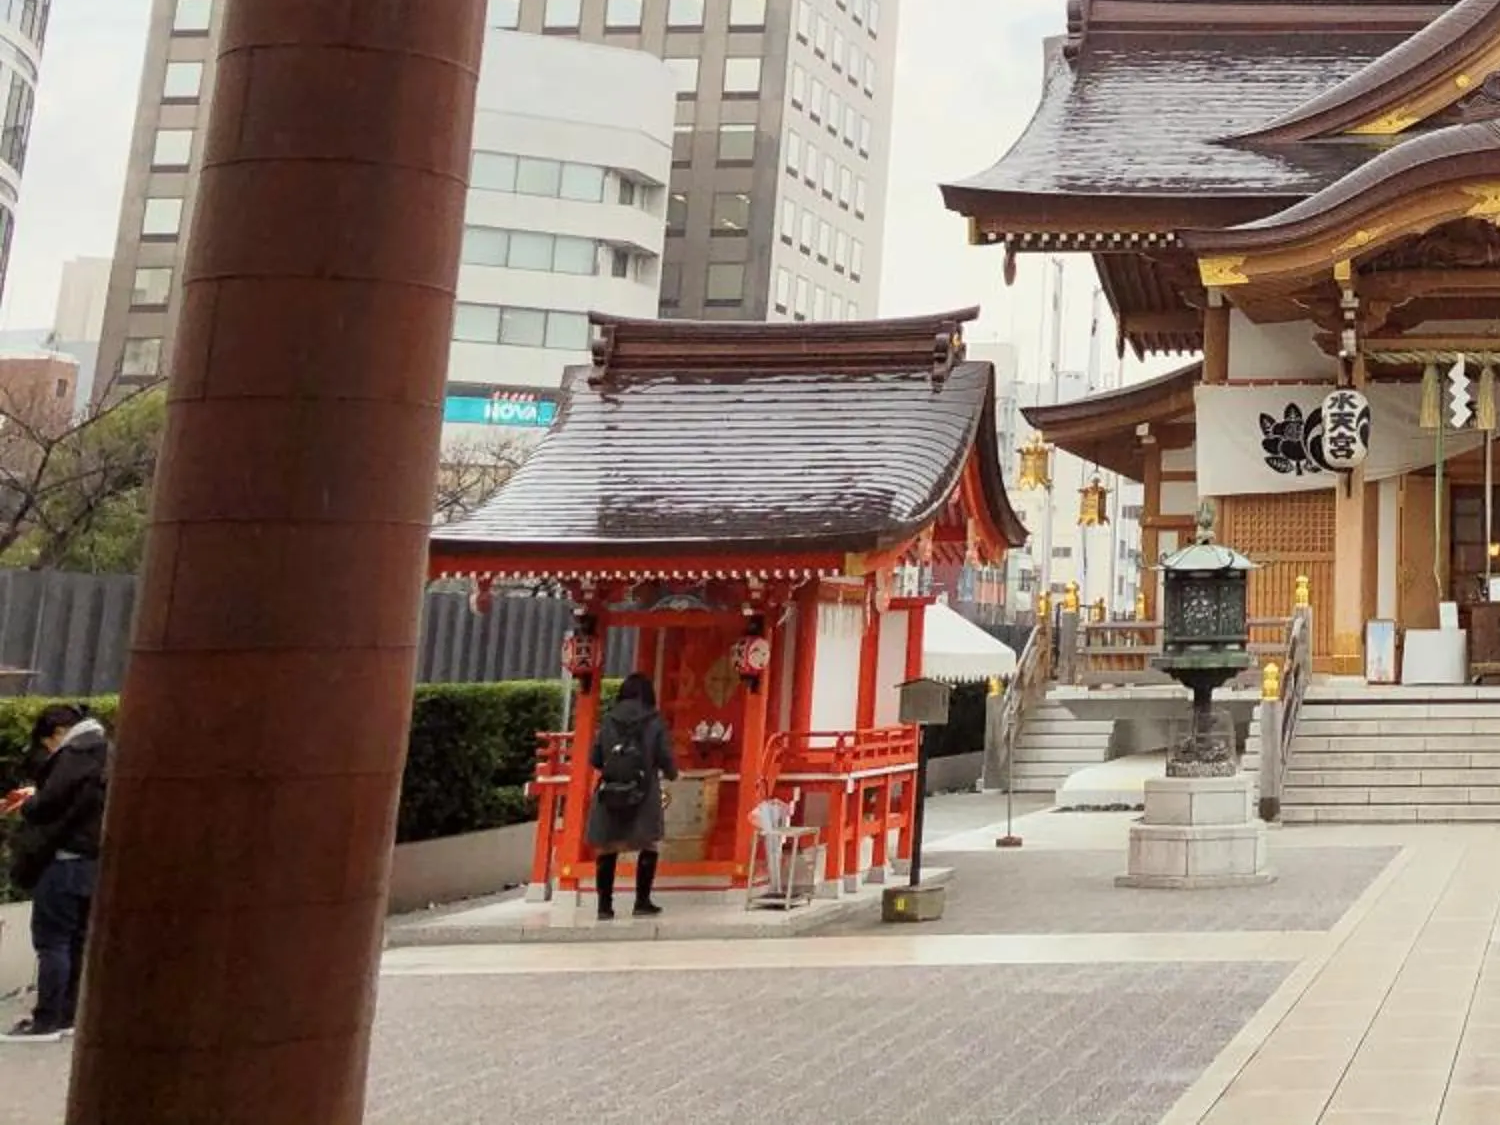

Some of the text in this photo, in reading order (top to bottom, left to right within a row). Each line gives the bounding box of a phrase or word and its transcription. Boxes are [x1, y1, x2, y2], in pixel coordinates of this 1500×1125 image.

[484, 401, 537, 421] NOVA
[1328, 392, 1358, 459] 水天宮
